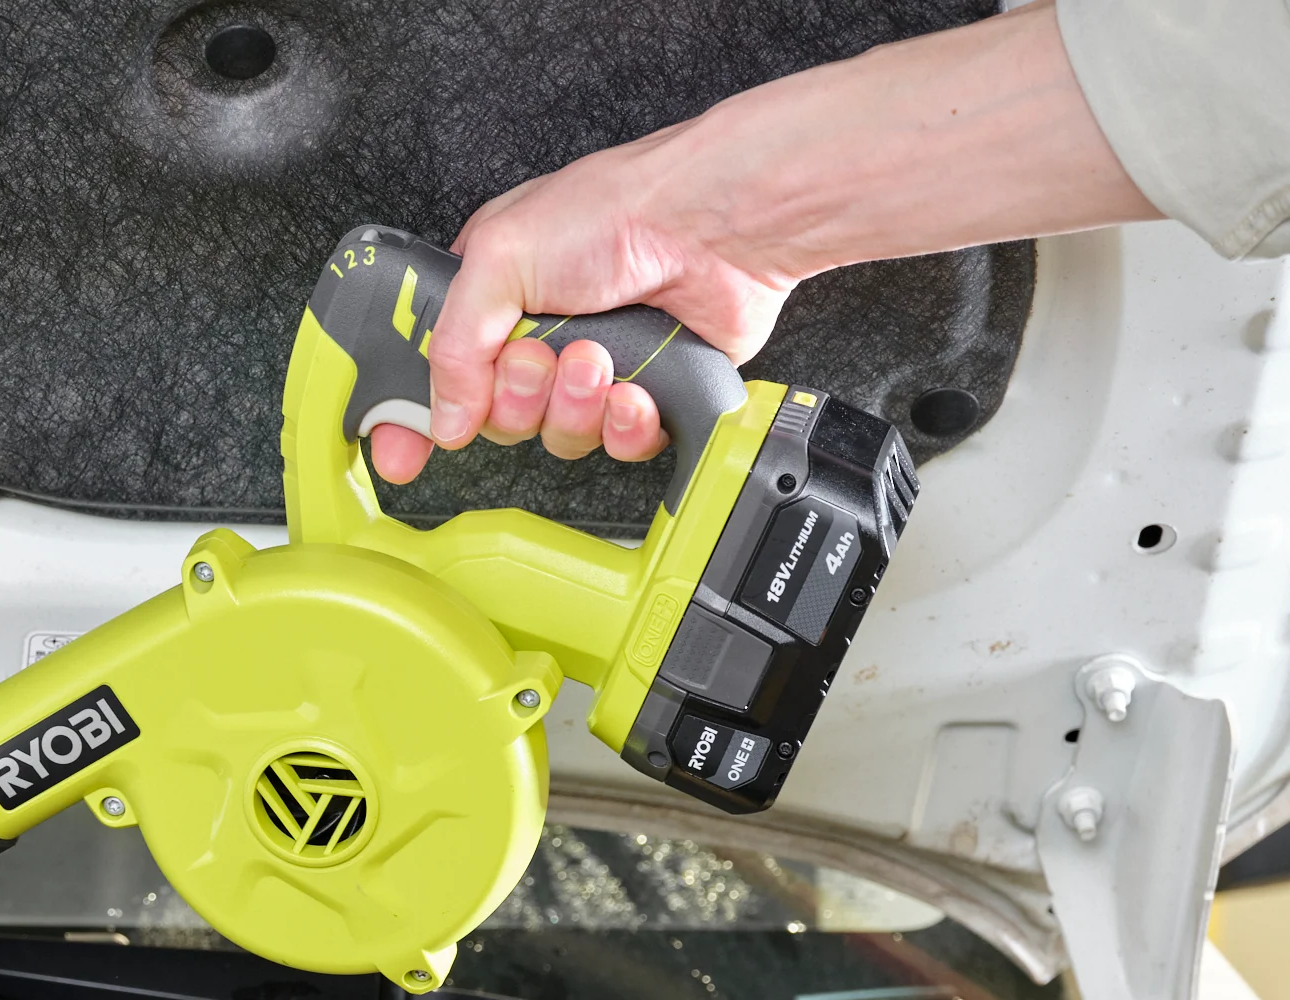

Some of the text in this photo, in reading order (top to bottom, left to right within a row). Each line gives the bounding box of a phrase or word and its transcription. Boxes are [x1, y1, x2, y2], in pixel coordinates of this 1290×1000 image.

[330, 246, 376, 278] 1 2 3
[826, 532, 855, 575] 4Ah
[688, 726, 719, 770] RYOBI
